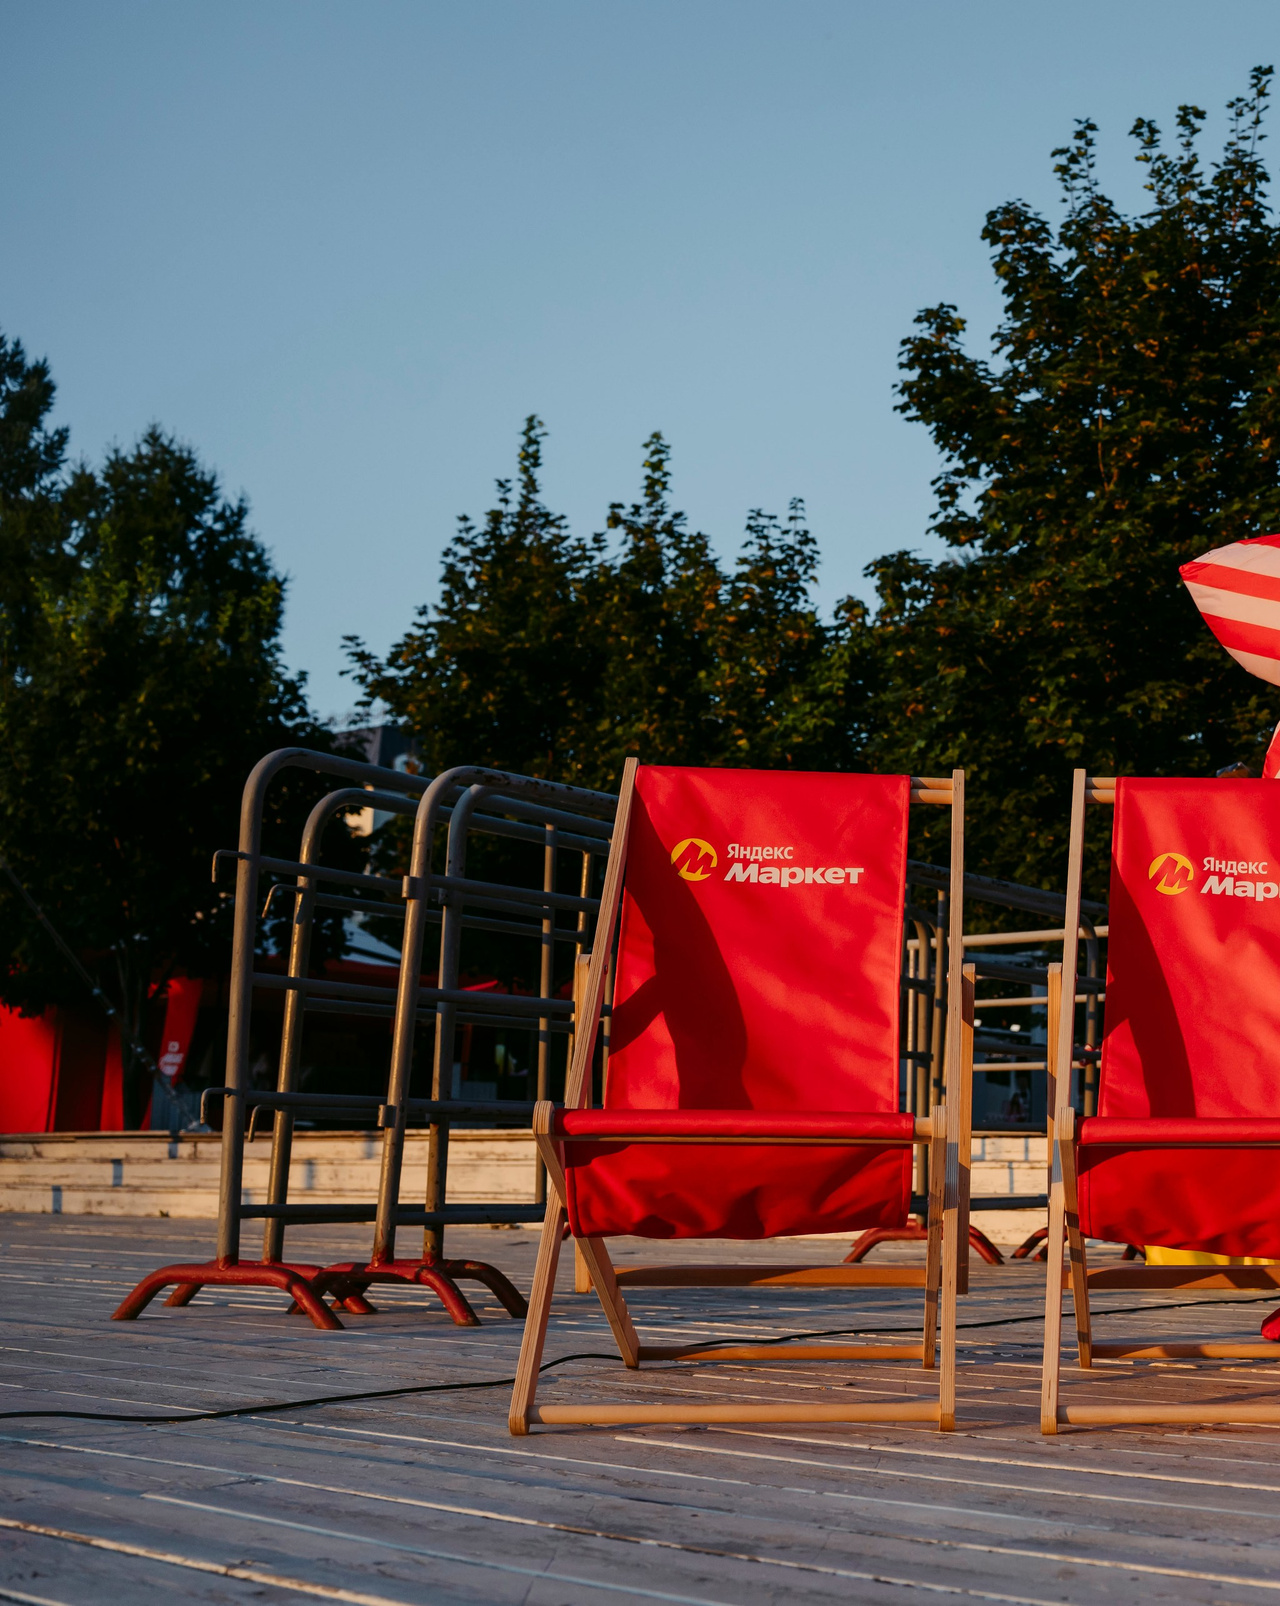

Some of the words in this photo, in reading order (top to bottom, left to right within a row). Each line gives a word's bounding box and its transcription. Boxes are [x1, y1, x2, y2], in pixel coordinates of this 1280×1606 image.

[726, 843, 794, 862] Яндекс
[723, 862, 865, 888] Маркет
[1202, 856, 1268, 875] Яндекс
